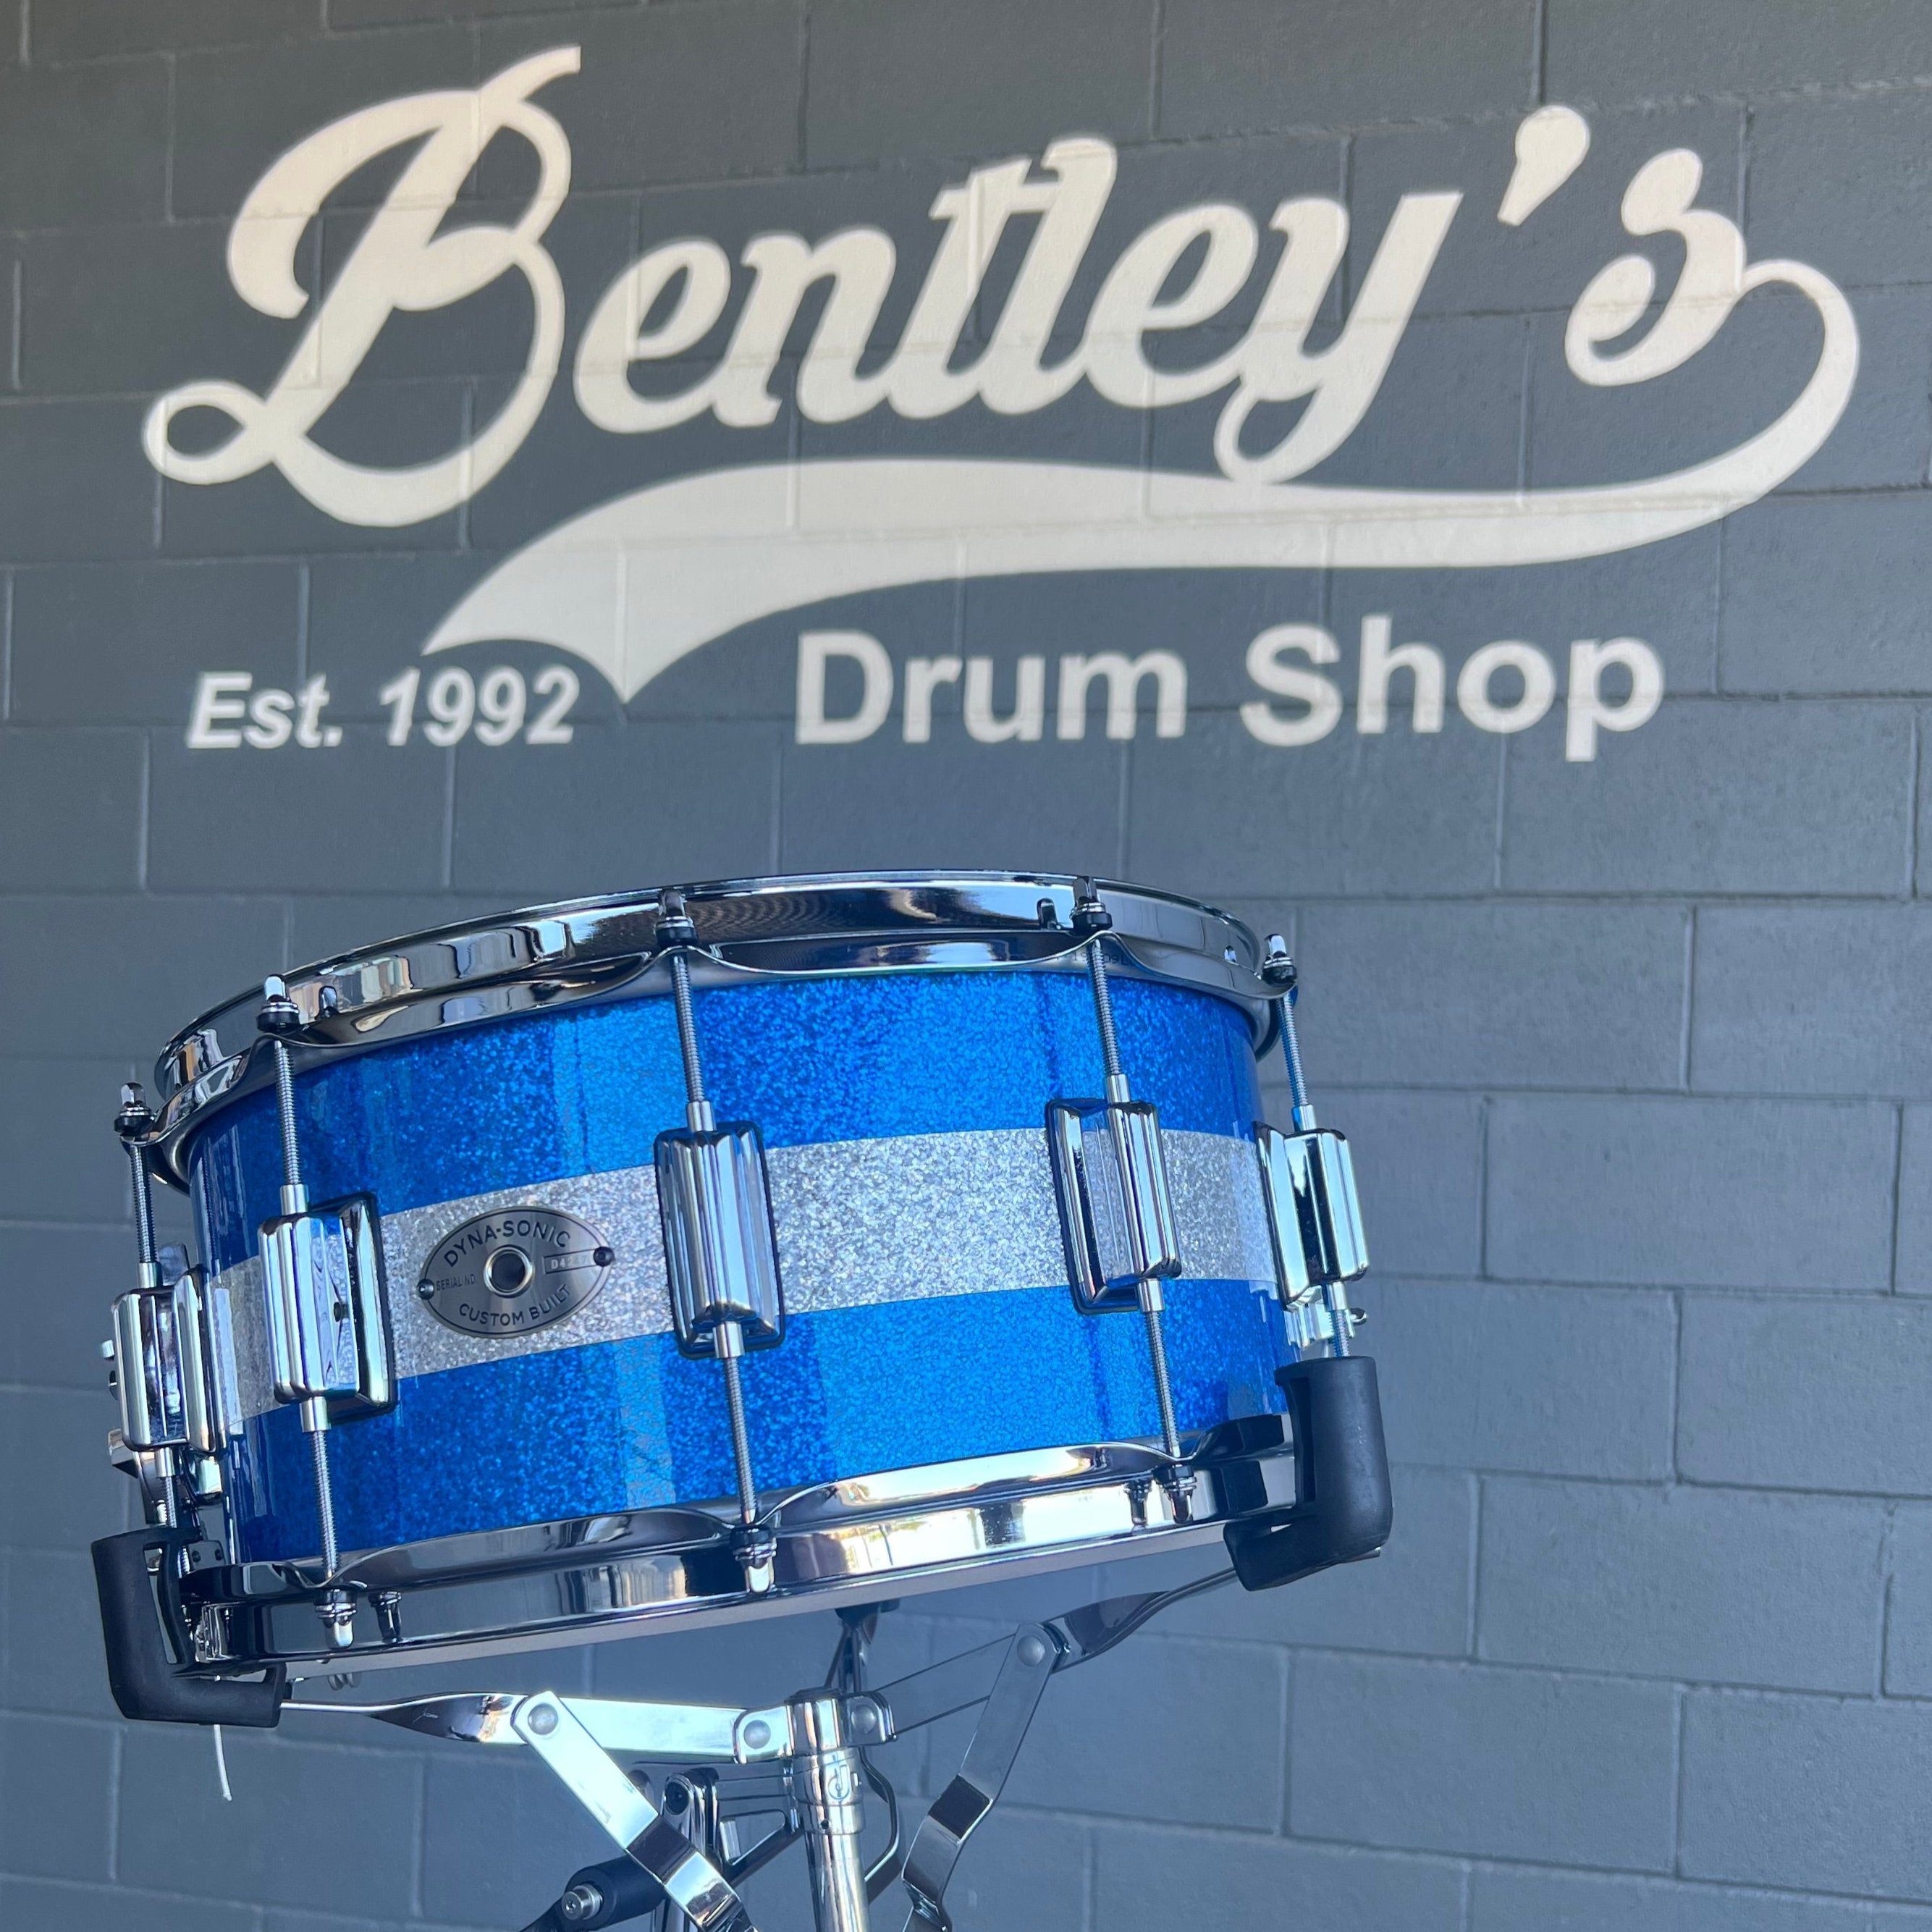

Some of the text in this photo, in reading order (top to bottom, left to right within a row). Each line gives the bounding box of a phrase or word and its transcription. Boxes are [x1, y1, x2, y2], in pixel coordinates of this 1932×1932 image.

[142, 45, 1861, 527] Bentley's
[186, 665, 580, 749] Est. 1992
[796, 615, 1664, 763] Drum Shop
[444, 1220, 570, 1267] DYNA-SONIC
[436, 1276, 463, 1291] SERIAL
[459, 1283, 570, 1326] CUSTOM BUILT
